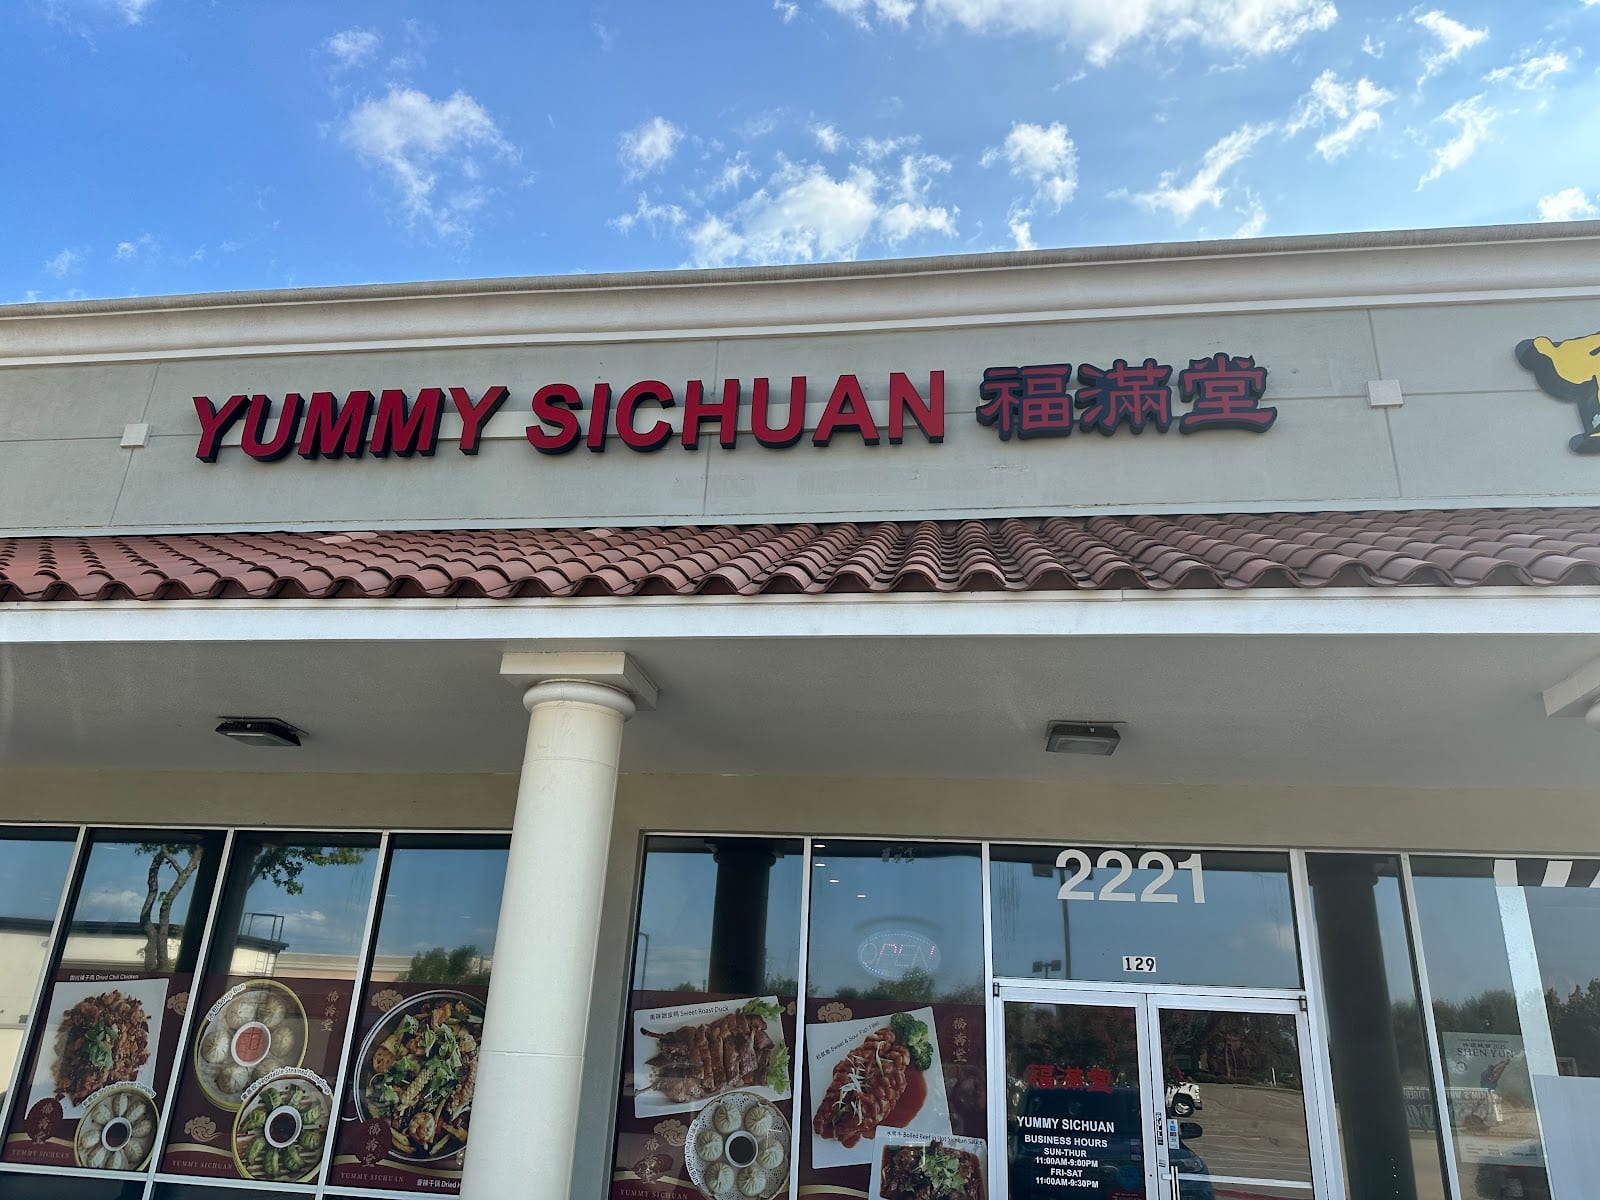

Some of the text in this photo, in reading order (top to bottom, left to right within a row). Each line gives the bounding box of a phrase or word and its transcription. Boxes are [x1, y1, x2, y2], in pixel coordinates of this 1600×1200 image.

[976, 352, 1277, 441] 福滿堂
[192, 370, 946, 463] YUMMY SICHUAN
[1055, 849, 1206, 904] 2221
[1124, 956, 1156, 972] 129
[232, 983, 246, 994] Bun
[680, 1004, 729, 1017] Sweet Roast Duck
[830, 1041, 844, 1054] Sweet
[1456, 1046, 1515, 1059] SHEN YUN
[258, 1067, 284, 1085] Vegetable
[1016, 1116, 1115, 1133] YUMMY SICHUAN
[903, 1131, 919, 1139] Boiled
[919, 1132, 931, 1140] Beef
[968, 1138, 983, 1146] Sauce
[1024, 1134, 1108, 1148] BUSINESS HOURS
[12, 1149, 70, 1160] YUMMY SICHUAN
[1043, 1147, 1087, 1157] SUN-THUR
[172, 1159, 232, 1170] YUMMY SICHUAN
[1035, 1156, 1099, 1168] 11:00AM-9:00PM
[341, 1172, 404, 1183] YUMMY SICHUAN
[1050, 1168, 1083, 1178] FRI-SAT
[441, 1180, 457, 1189] Dried
[1035, 1177, 1099, 1189] 11:00AM-9:30PM
[620, 1188, 688, 1200] YUMMY SICHUAN
